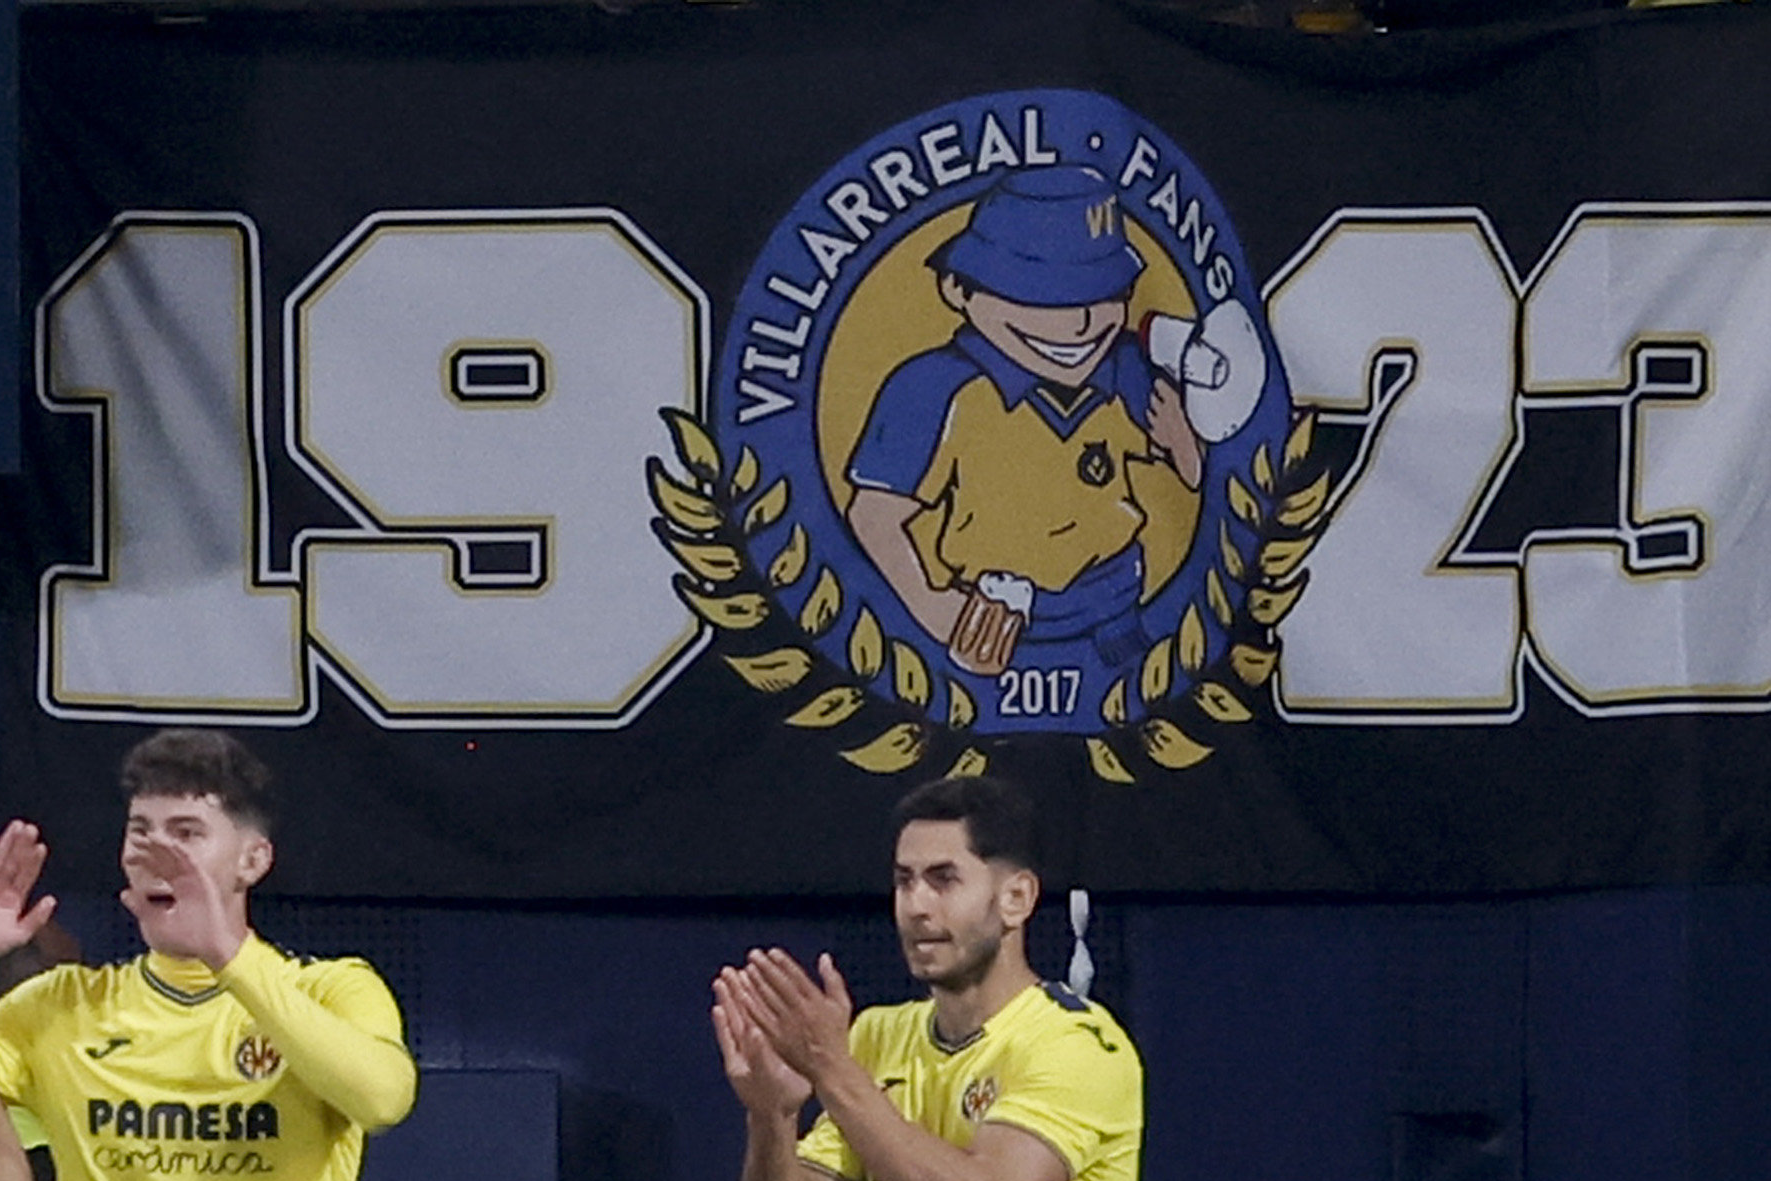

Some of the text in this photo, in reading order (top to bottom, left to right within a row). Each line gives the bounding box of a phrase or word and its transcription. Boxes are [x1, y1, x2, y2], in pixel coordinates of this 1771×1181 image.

[738, 108, 1234, 423] VILLARREAL FANS
[1000, 669, 1081, 715] 2017
[88, 1098, 279, 1141] PAMESA
